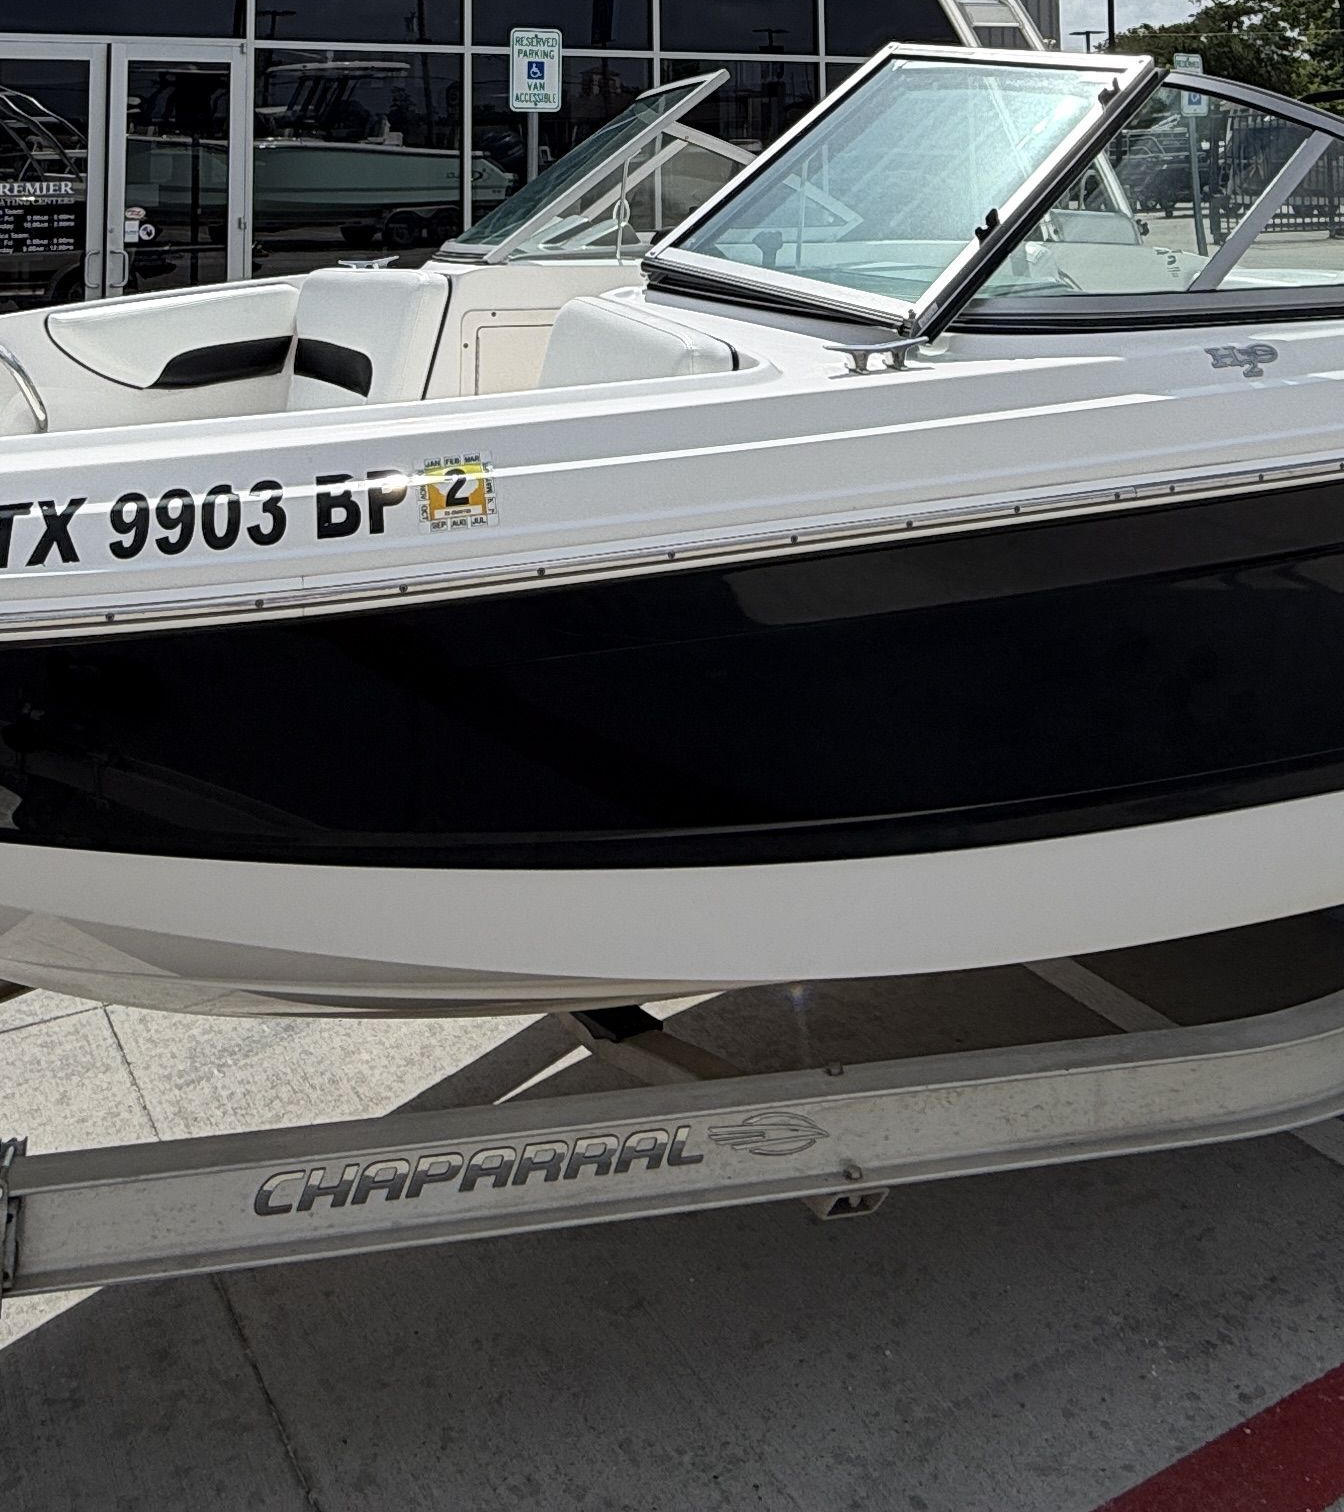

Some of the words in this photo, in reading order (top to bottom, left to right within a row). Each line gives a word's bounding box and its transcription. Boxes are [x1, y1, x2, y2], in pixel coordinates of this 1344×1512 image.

[515, 36, 557, 48] RESERVED
[517, 48, 555, 59] PARKING
[527, 81, 545, 91] VAN
[515, 92, 556, 104] ACCESSIBLE
[444, 468, 470, 507] 2
[108, 479, 287, 560] 9903
[315, 469, 408, 540] BP
[253, 1124, 705, 1217] CHAPARRAL
